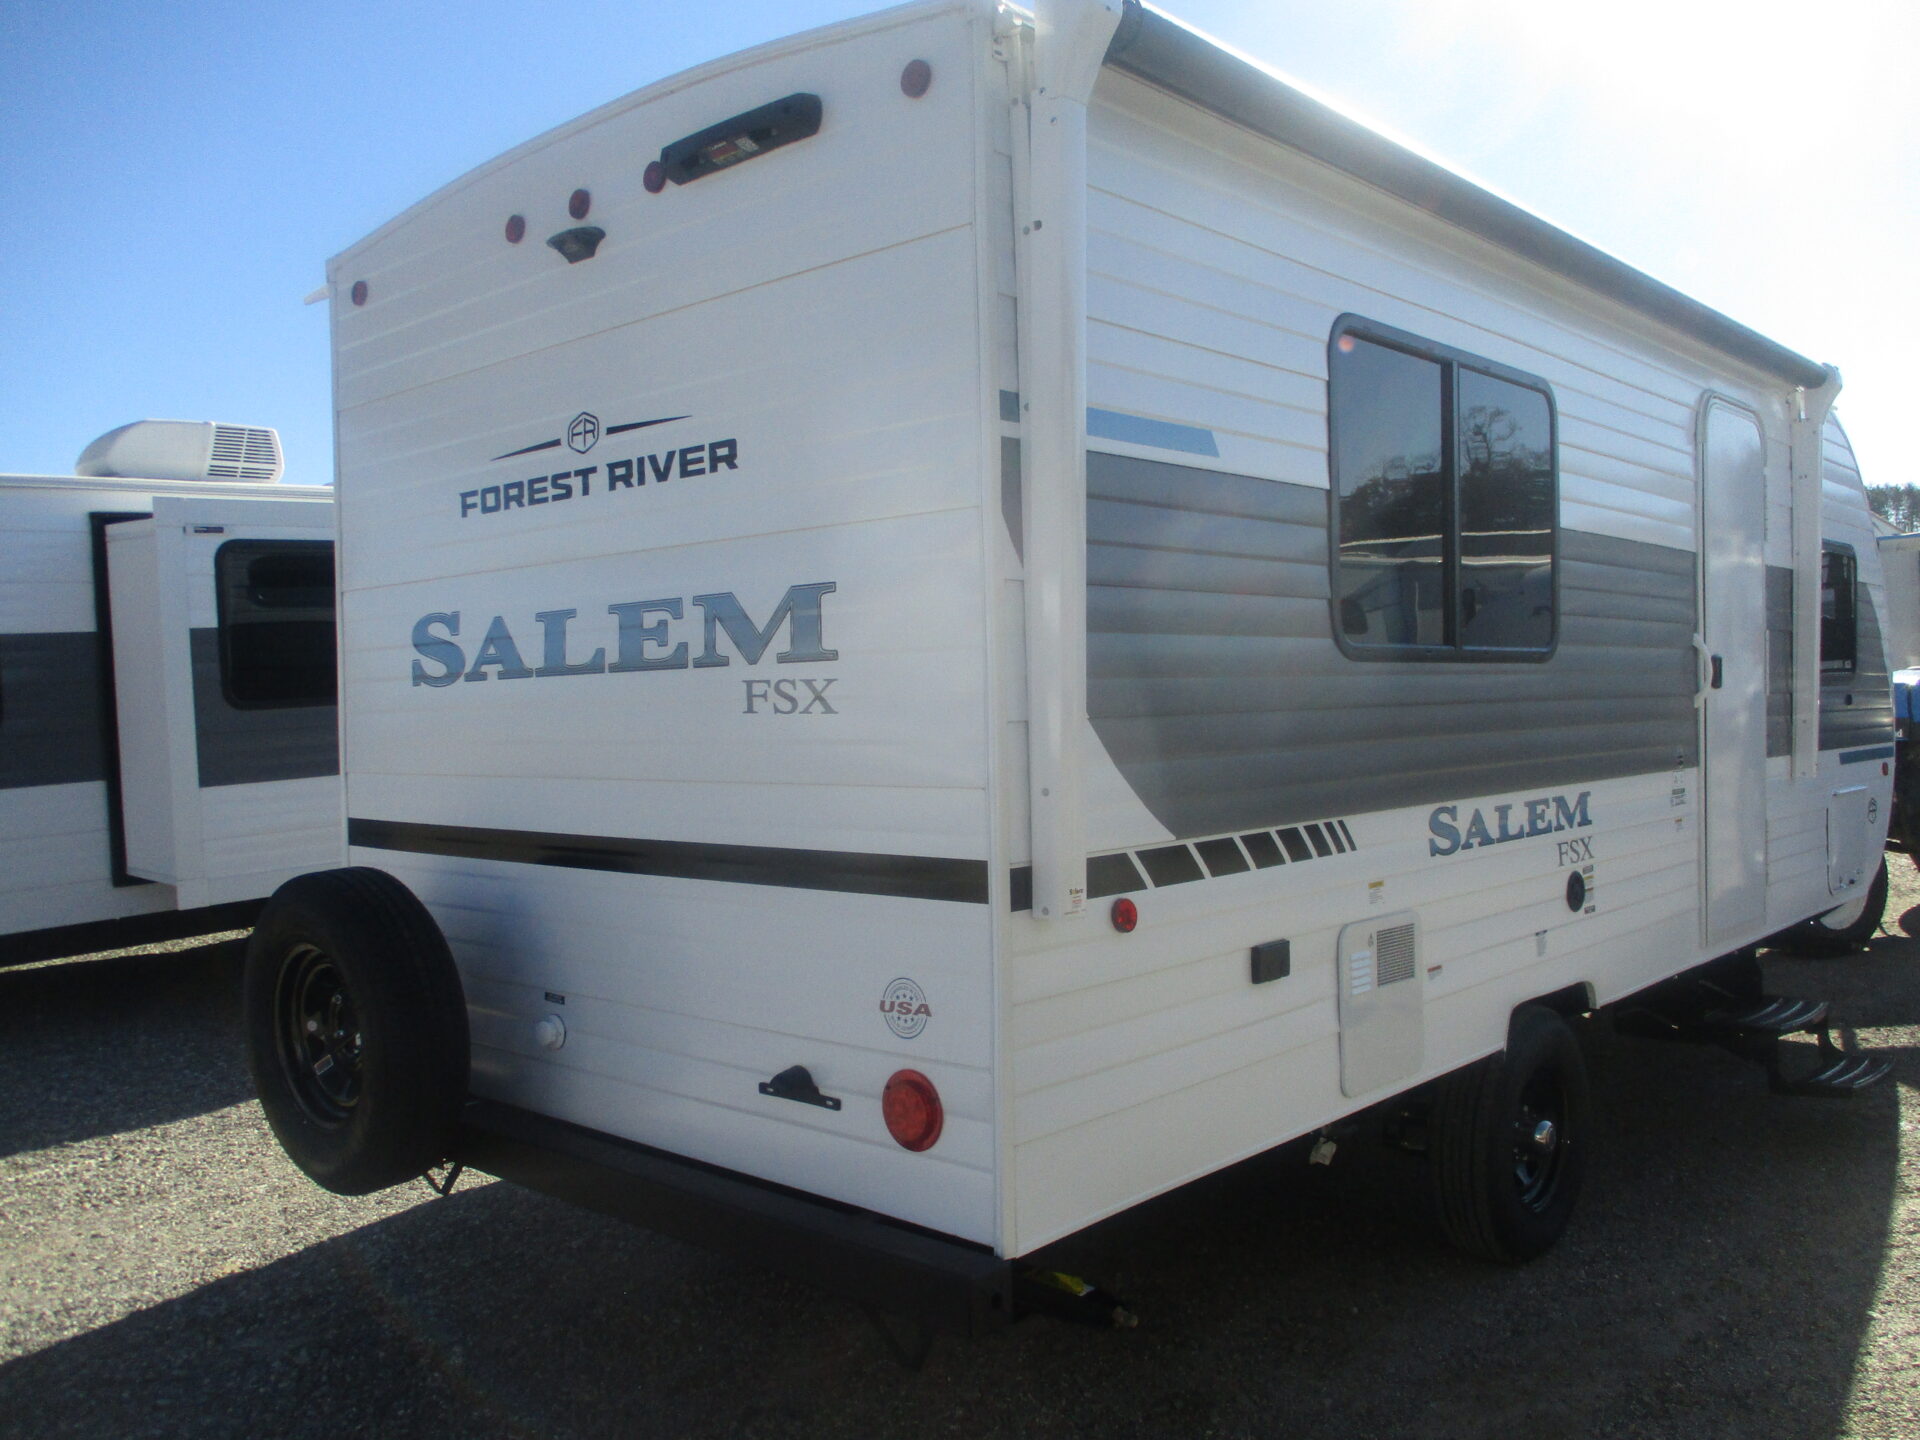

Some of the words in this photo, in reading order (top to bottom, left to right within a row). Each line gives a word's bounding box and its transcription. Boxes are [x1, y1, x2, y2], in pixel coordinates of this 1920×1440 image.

[459, 466, 598, 518] FOREST
[606, 438, 739, 492] RIVER
[411, 581, 839, 688] SALEM
[742, 678, 839, 715] FSX
[1428, 790, 1593, 857] SALEM
[1556, 836, 1595, 867] FSX
[879, 999, 932, 1017] USA
